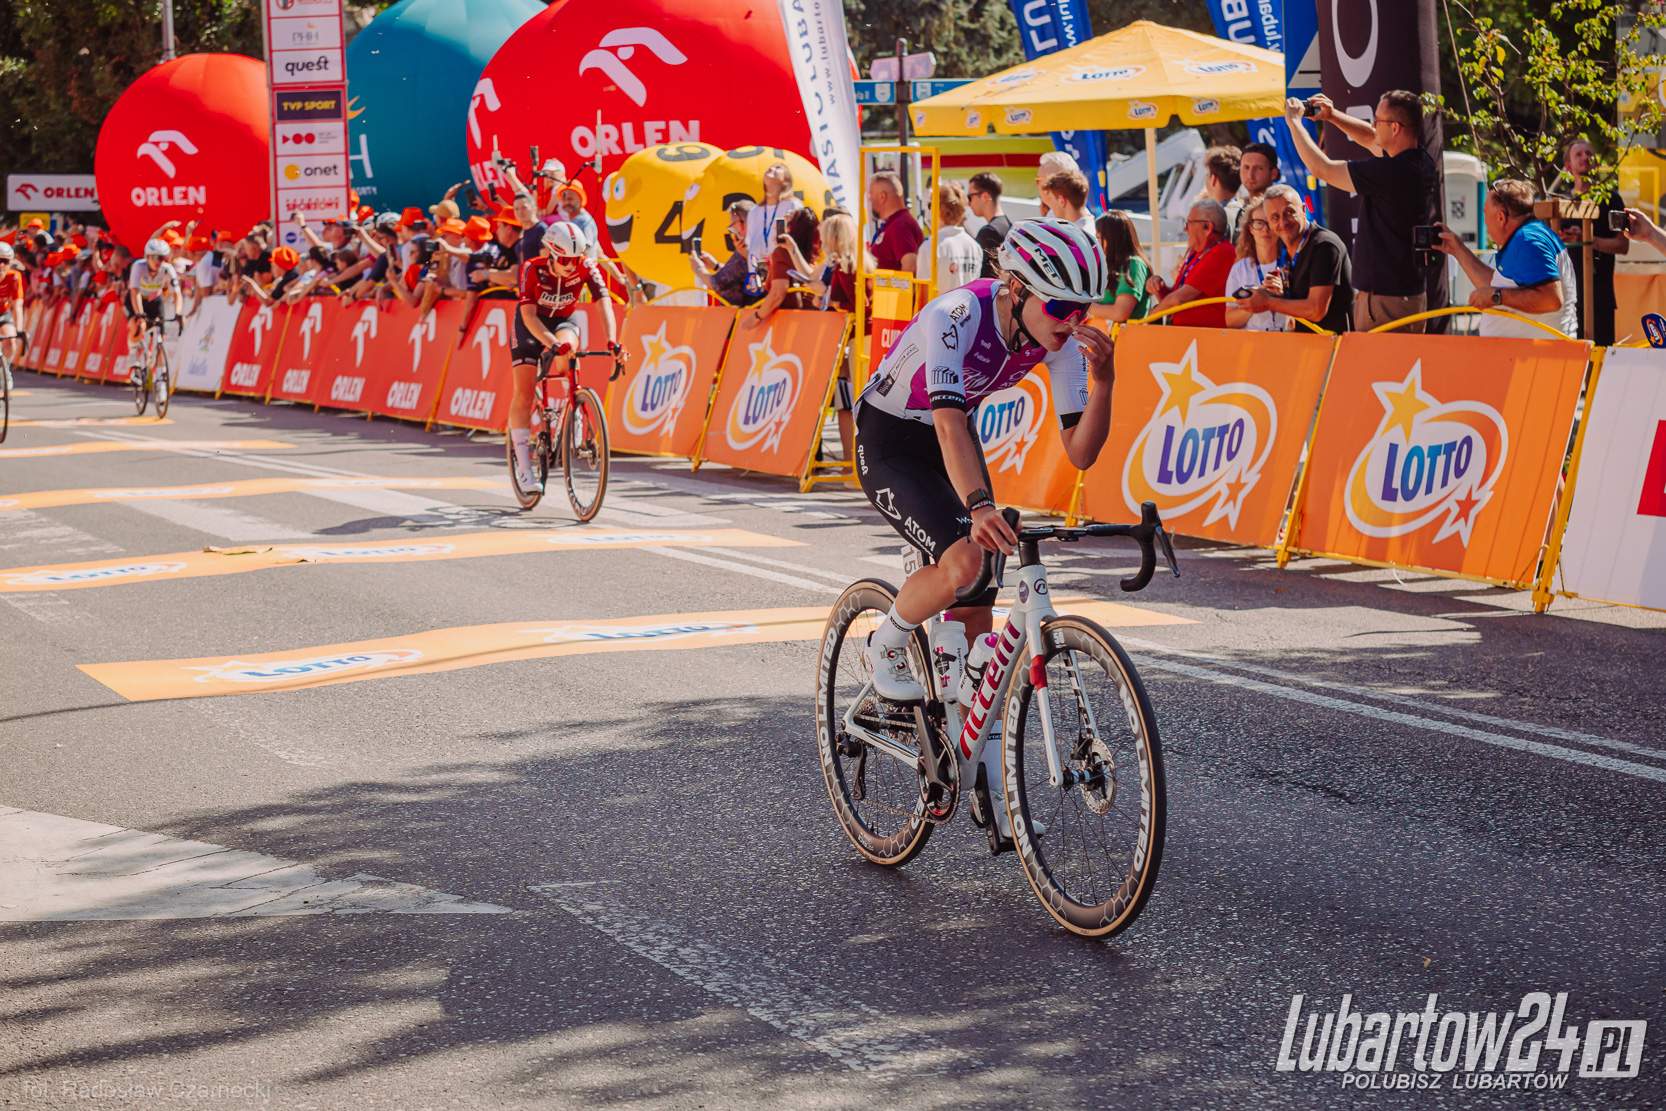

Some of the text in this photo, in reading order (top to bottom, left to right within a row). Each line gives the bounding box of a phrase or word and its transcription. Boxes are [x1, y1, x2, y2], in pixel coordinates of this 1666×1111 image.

[285, 56, 328, 76] quest
[283, 100, 336, 111] TVP SPORT
[571, 120, 700, 158] ORLEN
[304, 164, 338, 177] onet
[43, 187, 95, 199] ORLEN
[131, 185, 206, 207] ORLEN
[1034, 247, 1060, 280] MET
[950, 303, 967, 323] ATOM
[387, 381, 422, 410] ORLEN
[450, 387, 496, 420] ORLEN
[641, 368, 682, 412] LOTTO
[743, 377, 787, 426] LOTTO
[975, 396, 1025, 444] OTTO
[858, 445, 869, 475] quest
[1157, 418, 1245, 485] LOTTO
[1381, 435, 1473, 503] LOTTO
[904, 516, 936, 552] ATOM
[244, 655, 372, 678] LOTTO
